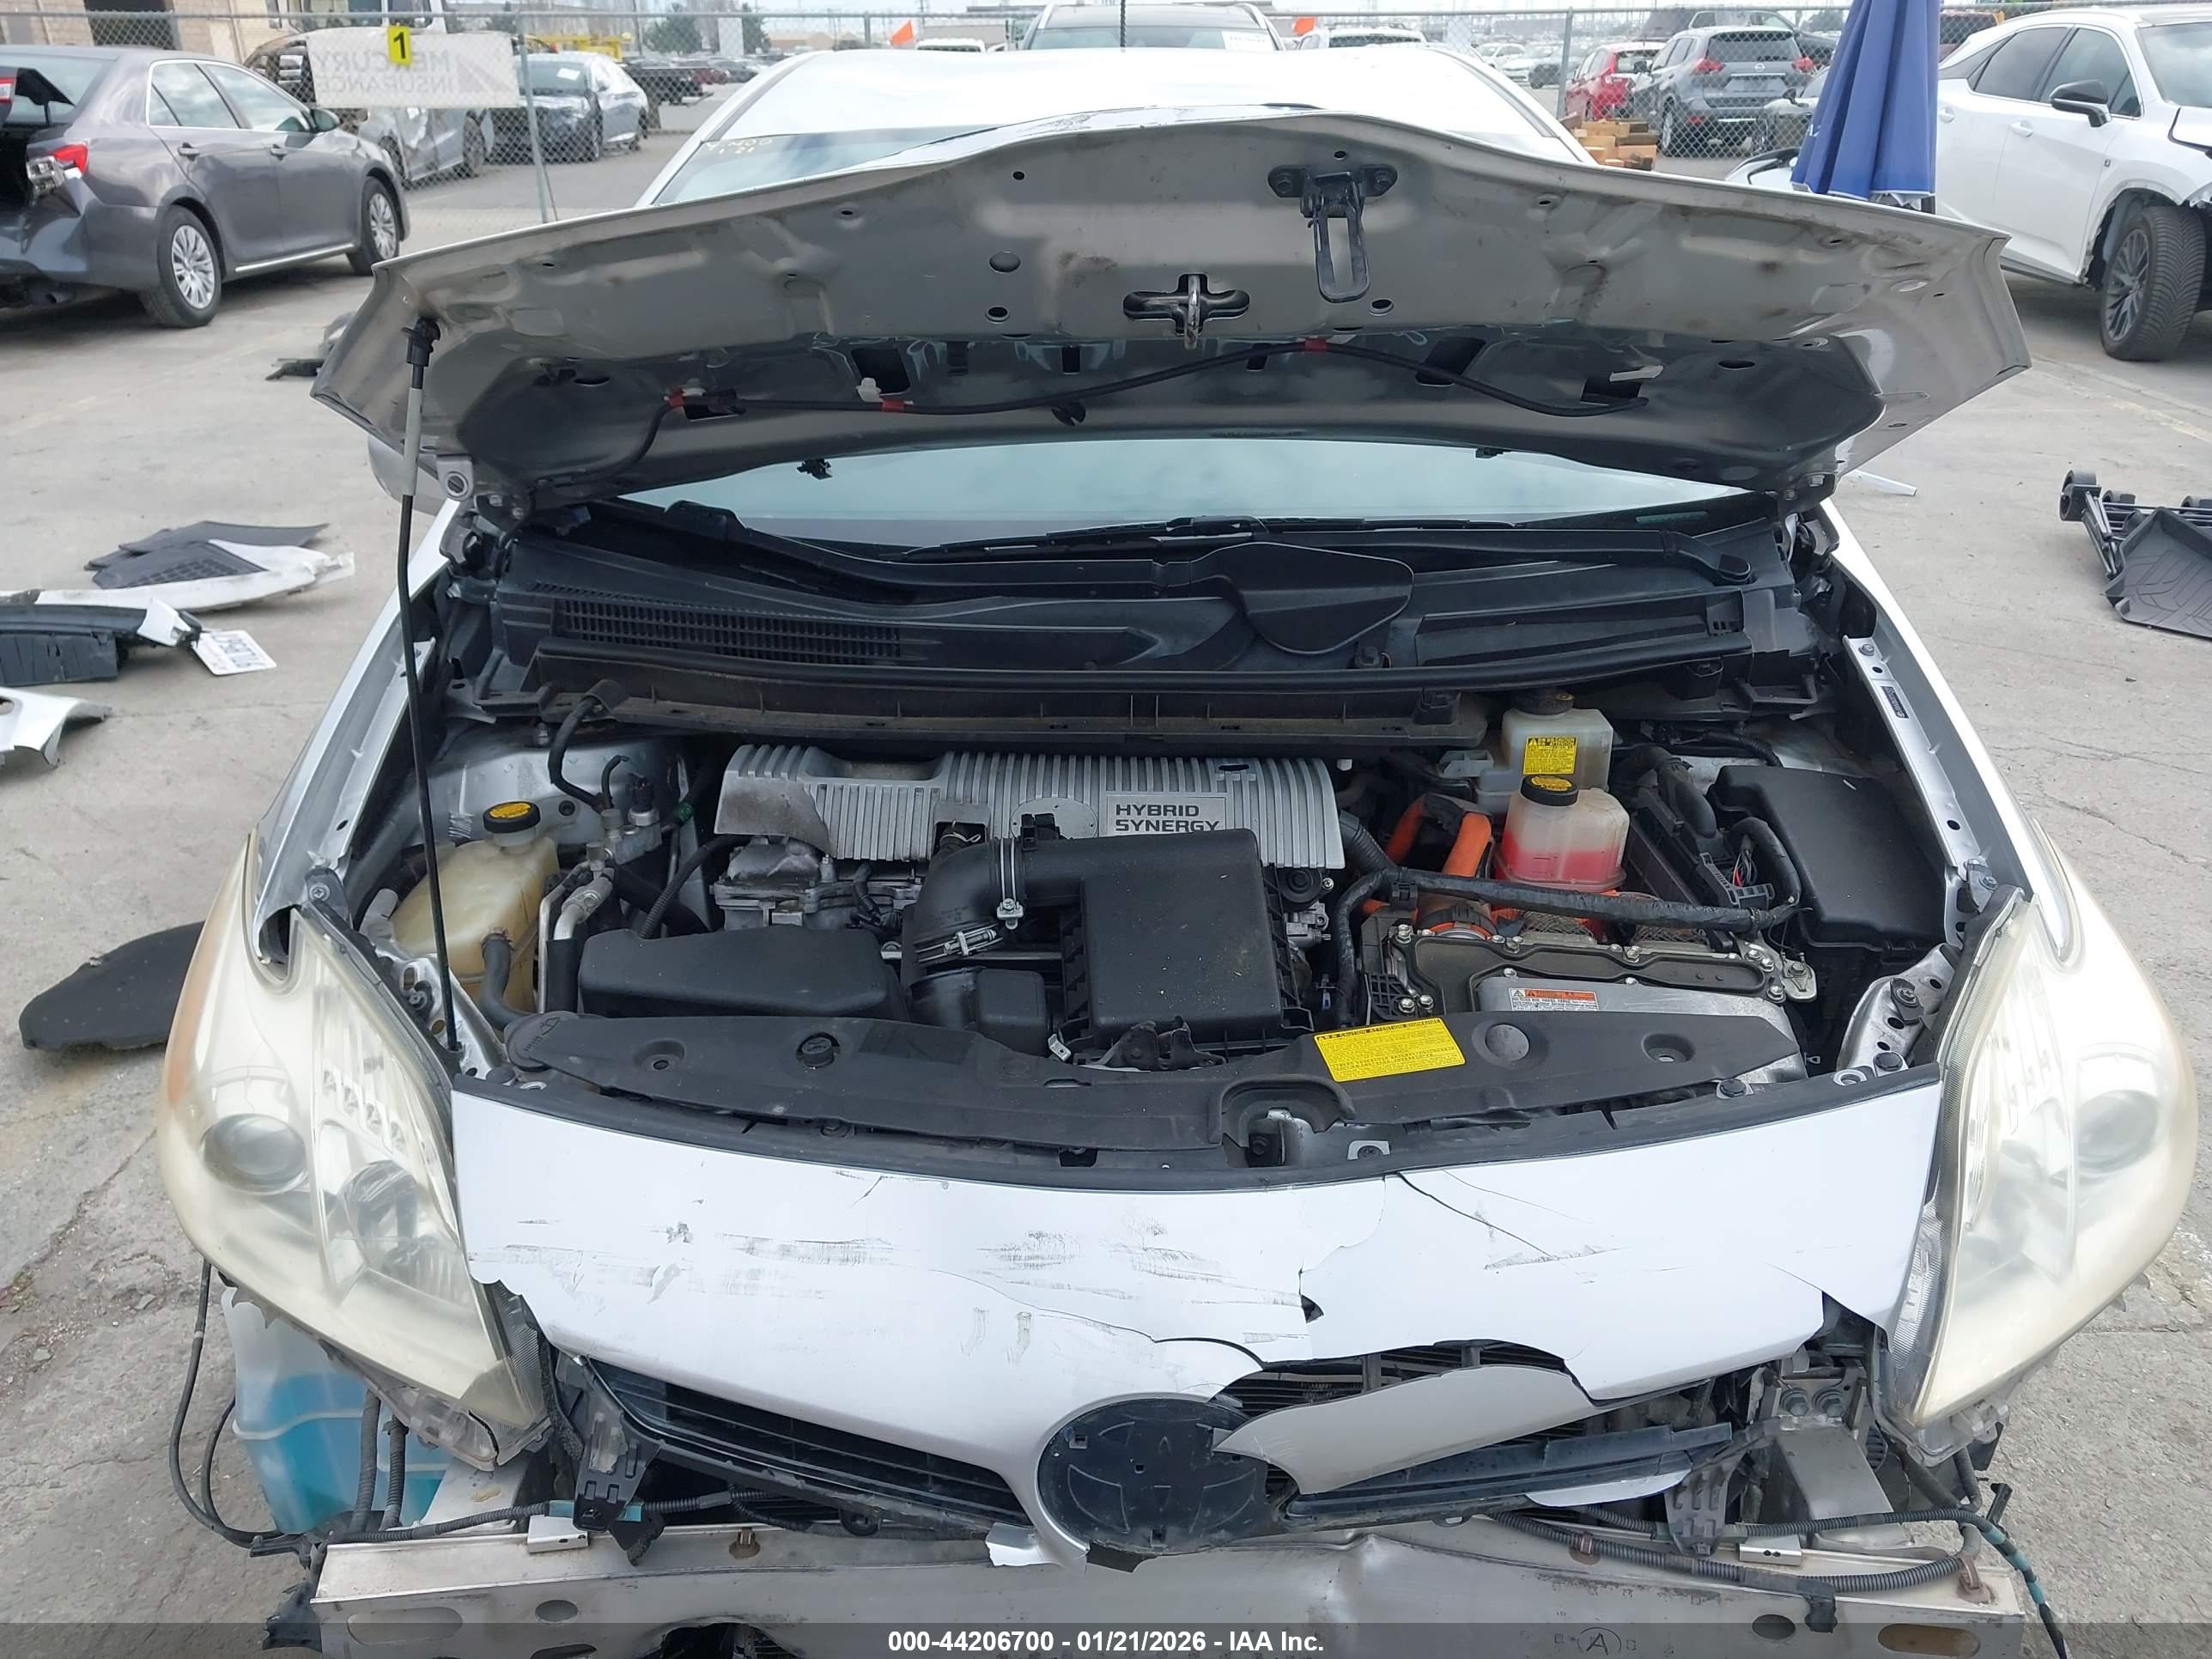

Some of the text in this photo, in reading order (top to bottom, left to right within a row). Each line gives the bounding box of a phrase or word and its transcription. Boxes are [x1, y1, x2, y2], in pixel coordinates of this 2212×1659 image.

[393, 32, 406, 59] 1
[1115, 804, 1200, 817] HYBRID
[1115, 819, 1219, 832] SYNERGY
